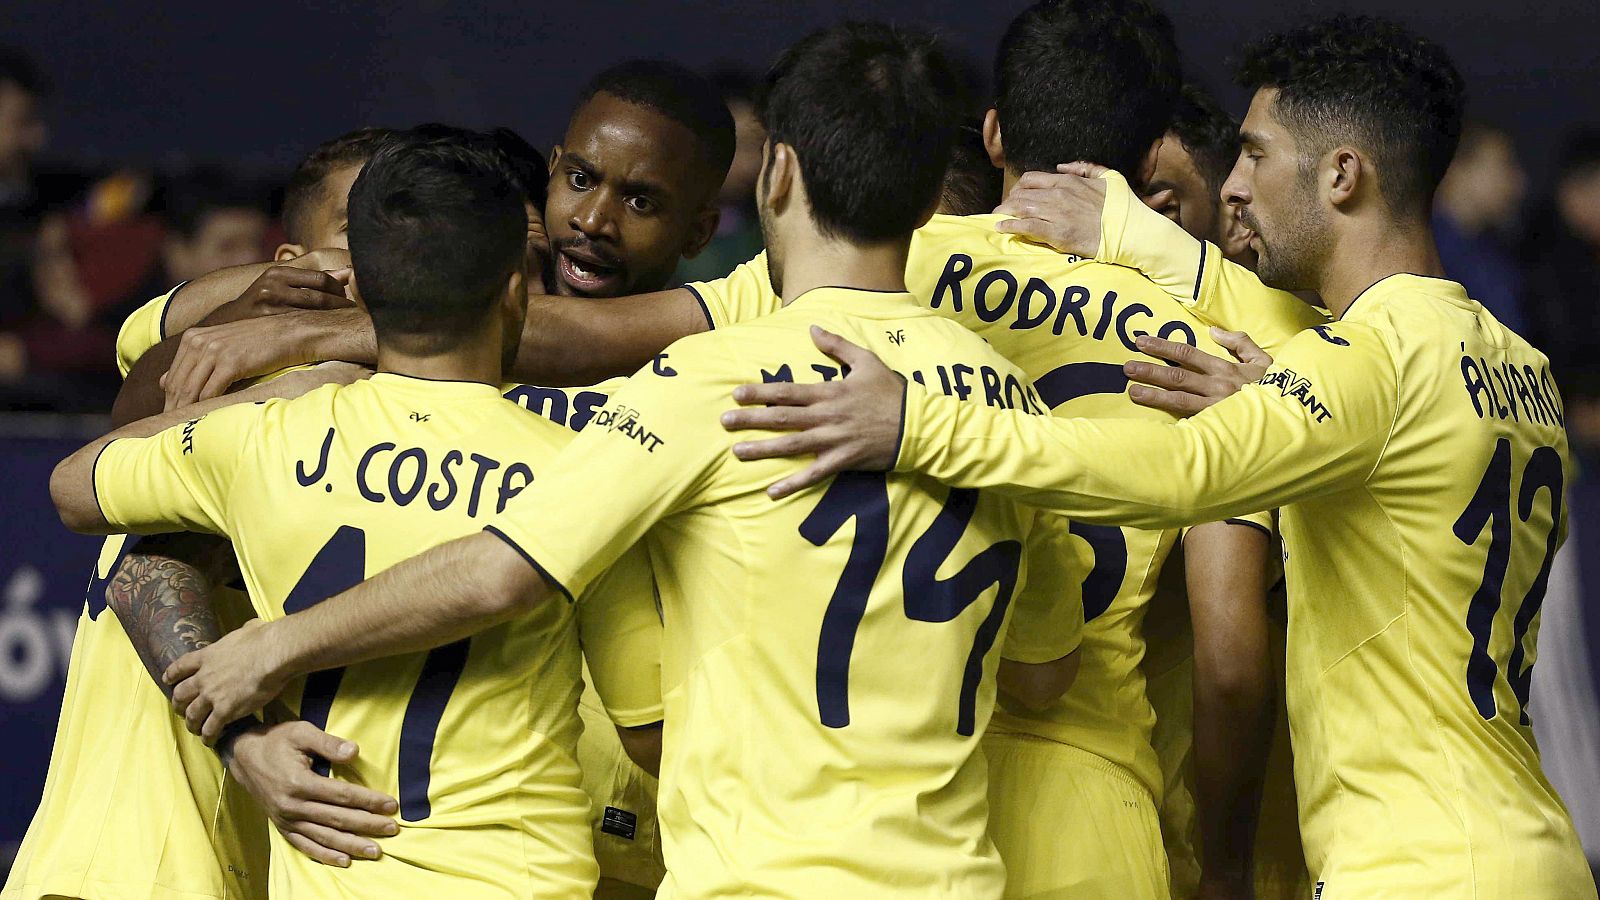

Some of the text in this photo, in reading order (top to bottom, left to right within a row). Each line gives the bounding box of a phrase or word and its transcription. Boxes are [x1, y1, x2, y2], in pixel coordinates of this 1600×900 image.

[930, 253, 1197, 367] RODRIGO
[594, 404, 665, 454] DAVANT
[1257, 368, 1333, 424] DAVANT
[798, 469, 1023, 737] 14
[1452, 437, 1564, 726] 12
